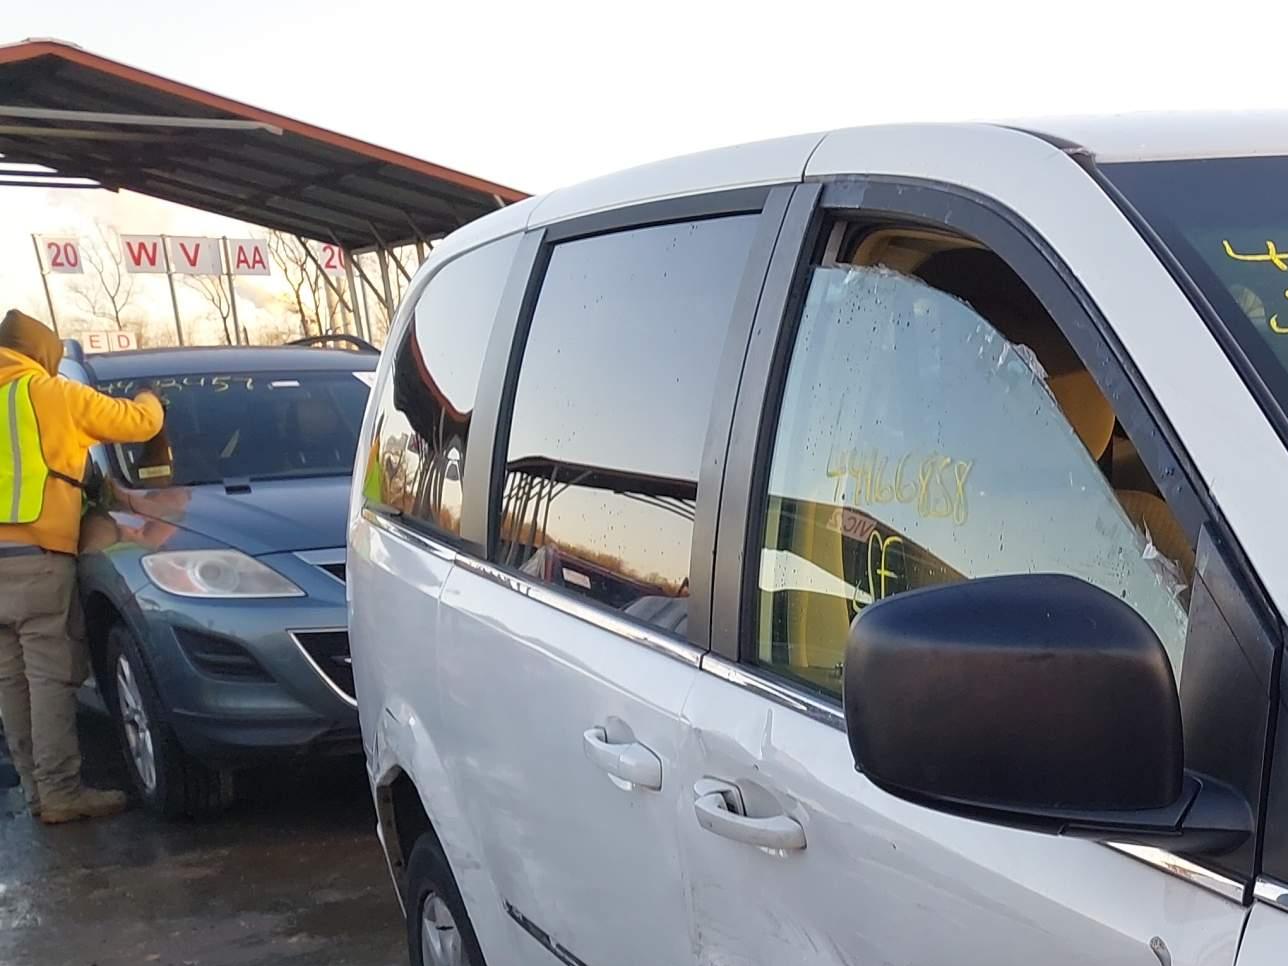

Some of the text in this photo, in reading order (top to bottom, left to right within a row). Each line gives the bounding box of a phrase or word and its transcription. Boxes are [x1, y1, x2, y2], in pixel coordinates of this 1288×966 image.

[47, 241, 79, 268] 20
[126, 241, 201, 268] W V
[235, 245, 267, 270] AA
